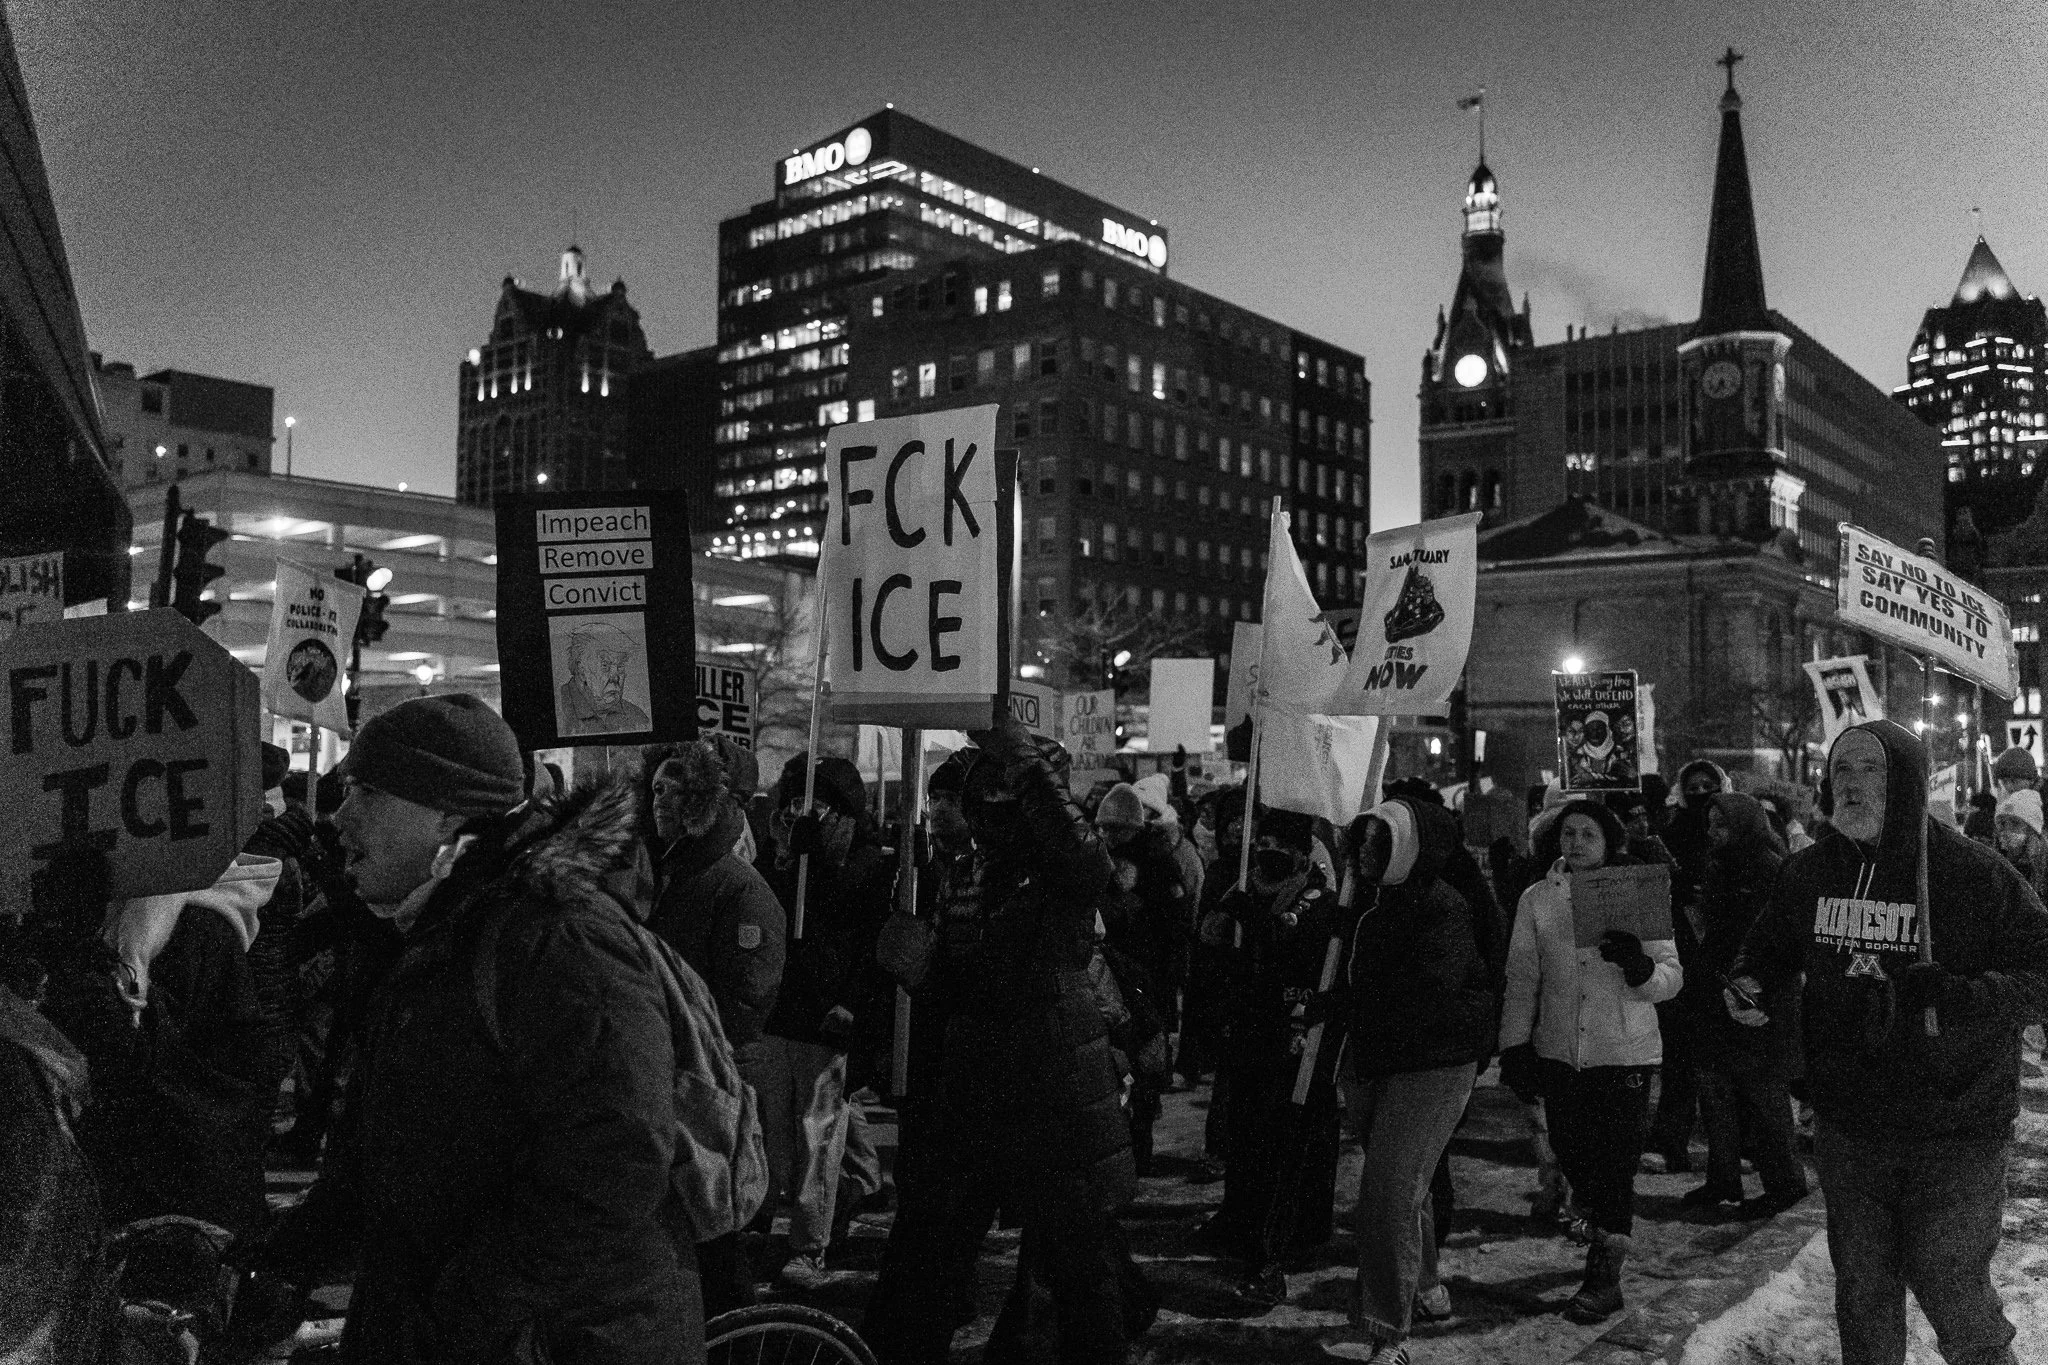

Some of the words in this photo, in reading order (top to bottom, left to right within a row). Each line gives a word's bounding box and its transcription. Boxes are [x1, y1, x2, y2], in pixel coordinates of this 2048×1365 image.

[785, 142, 845, 185] BMO
[1102, 217, 1149, 257] BMO
[840, 437, 981, 549] FCK
[542, 508, 648, 537] Impeach
[544, 547, 645, 569] Remove
[310, 587, 325, 601] NO
[549, 580, 642, 605] Convict
[1858, 543, 1894, 569] SAY
[1901, 560, 1928, 583] NO
[1933, 573, 1956, 598] TO
[1961, 591, 1988, 617] ICE
[1862, 565, 1906, 596] SAY
[1915, 584, 1955, 619] YES
[1962, 609, 1988, 639] TO
[852, 573, 962, 672] ICE
[1860, 589, 1986, 659] COMMUNITY
[1363, 661, 1429, 690] NOW
[1595, 689, 1634, 702] DEFEND
[9, 651, 199, 755] FUCK
[1012, 697, 1038, 723] NO
[31, 758, 210, 860] ICE
[1815, 935, 1861, 949] GOLDEN
